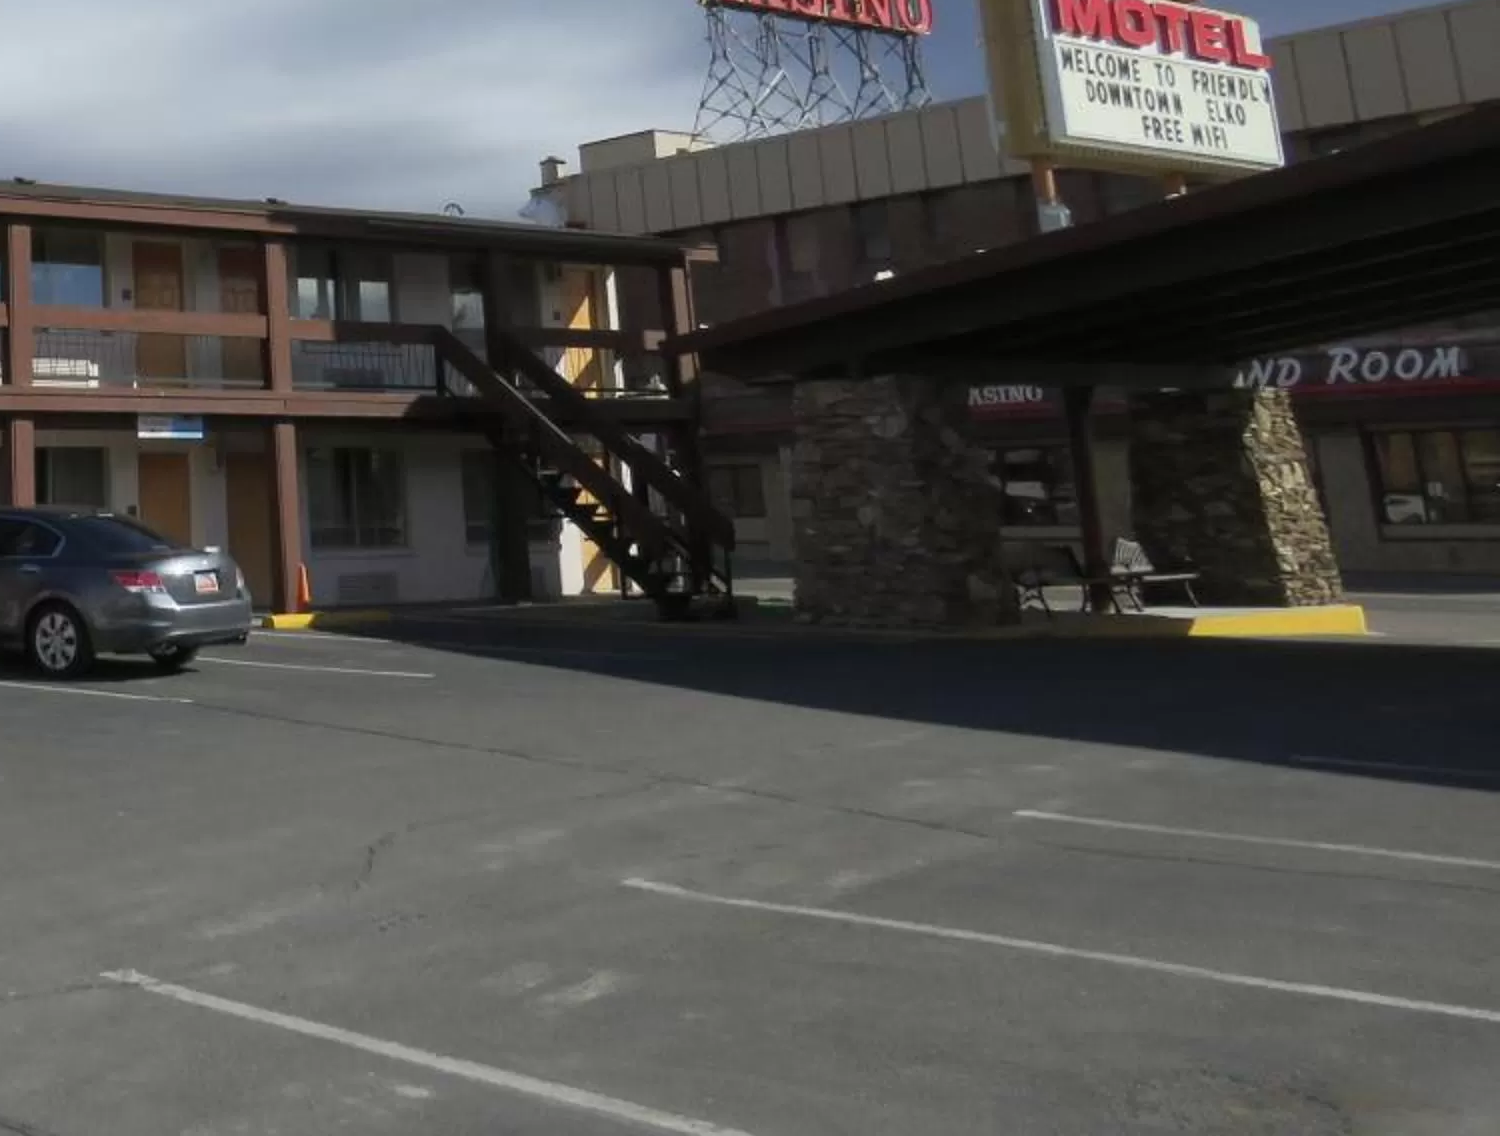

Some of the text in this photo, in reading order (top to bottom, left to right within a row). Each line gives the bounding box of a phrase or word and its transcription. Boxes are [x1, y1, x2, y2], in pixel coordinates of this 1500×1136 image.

[1061, 48, 1270, 103] WELCOME TO FRIENDLY
[1086, 80, 1245, 125] DOWNTOWN ELKO
[1142, 117, 1227, 148] FREE WIFI
[1244, 346, 1462, 388] ND ROOM
[967, 384, 1044, 406] ASINO
